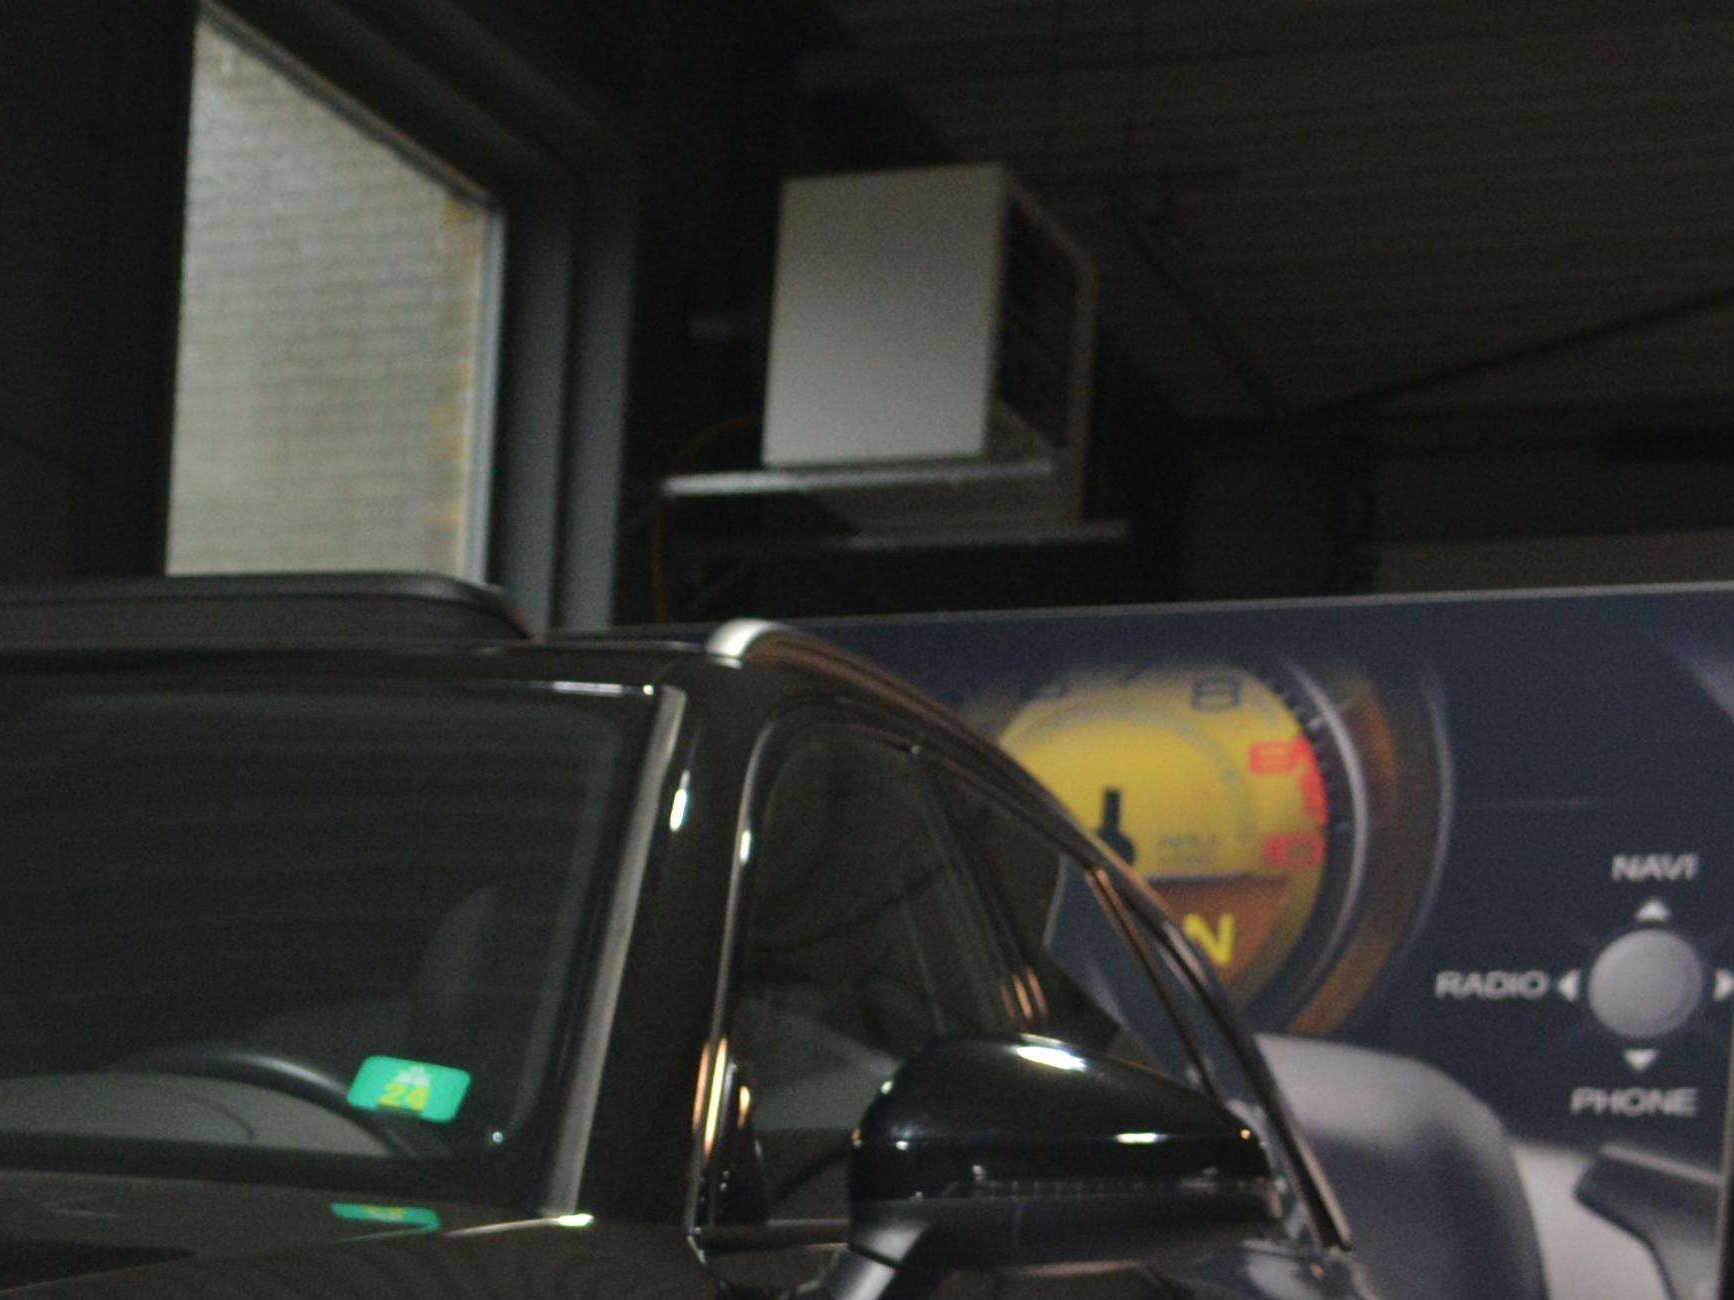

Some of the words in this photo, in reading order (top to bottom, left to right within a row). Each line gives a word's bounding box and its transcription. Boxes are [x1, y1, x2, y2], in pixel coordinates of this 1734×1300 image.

[1611, 853, 1698, 881] NAVI
[1435, 970, 1550, 999] RADIO
[1570, 1086, 1697, 1116] PHONE
